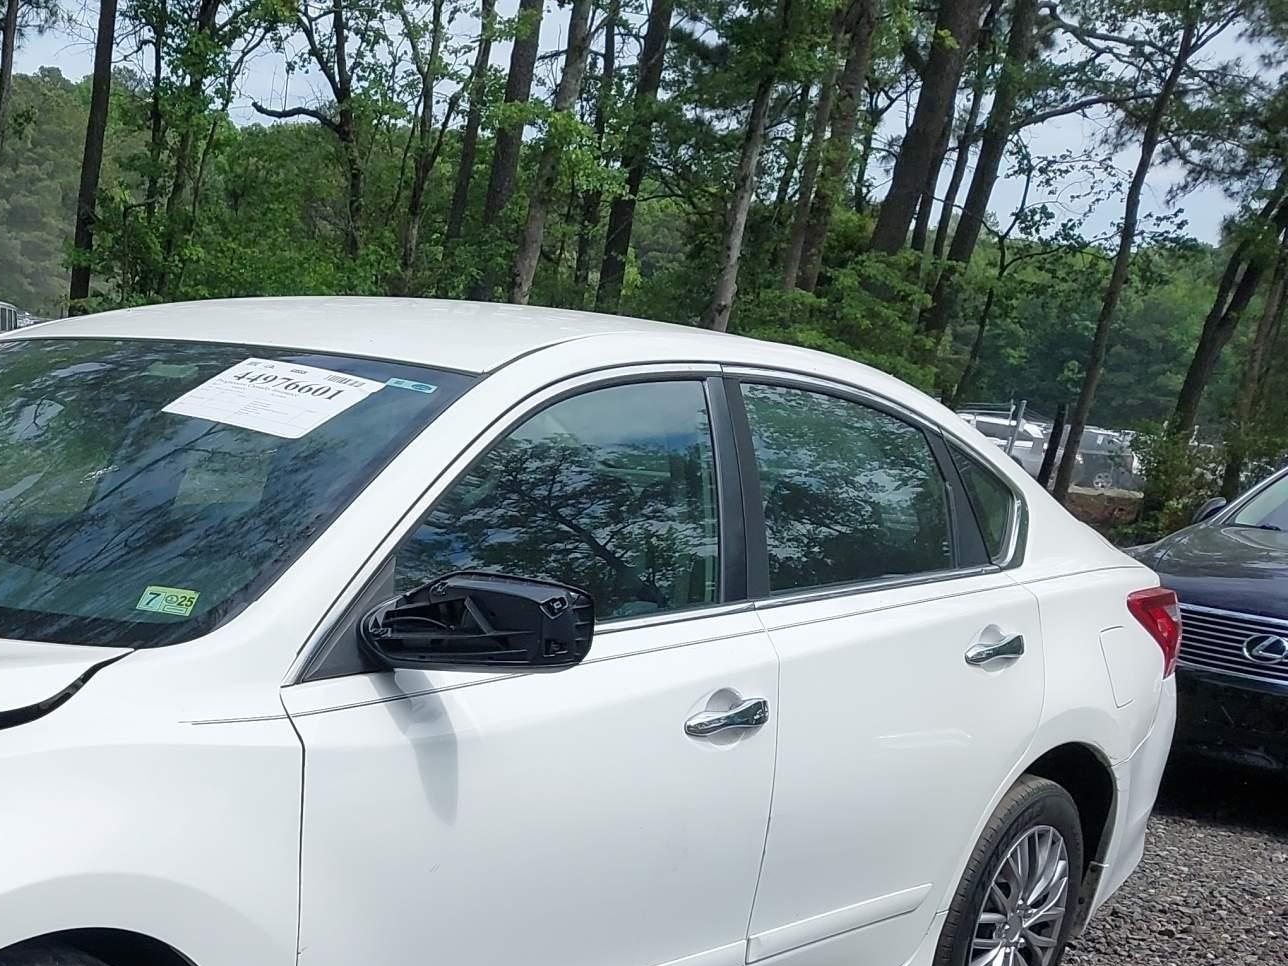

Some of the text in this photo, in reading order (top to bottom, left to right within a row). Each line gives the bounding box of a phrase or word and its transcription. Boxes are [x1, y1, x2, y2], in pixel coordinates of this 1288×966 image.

[233, 371, 345, 401] 44976601
[146, 592, 195, 607] 7 25
